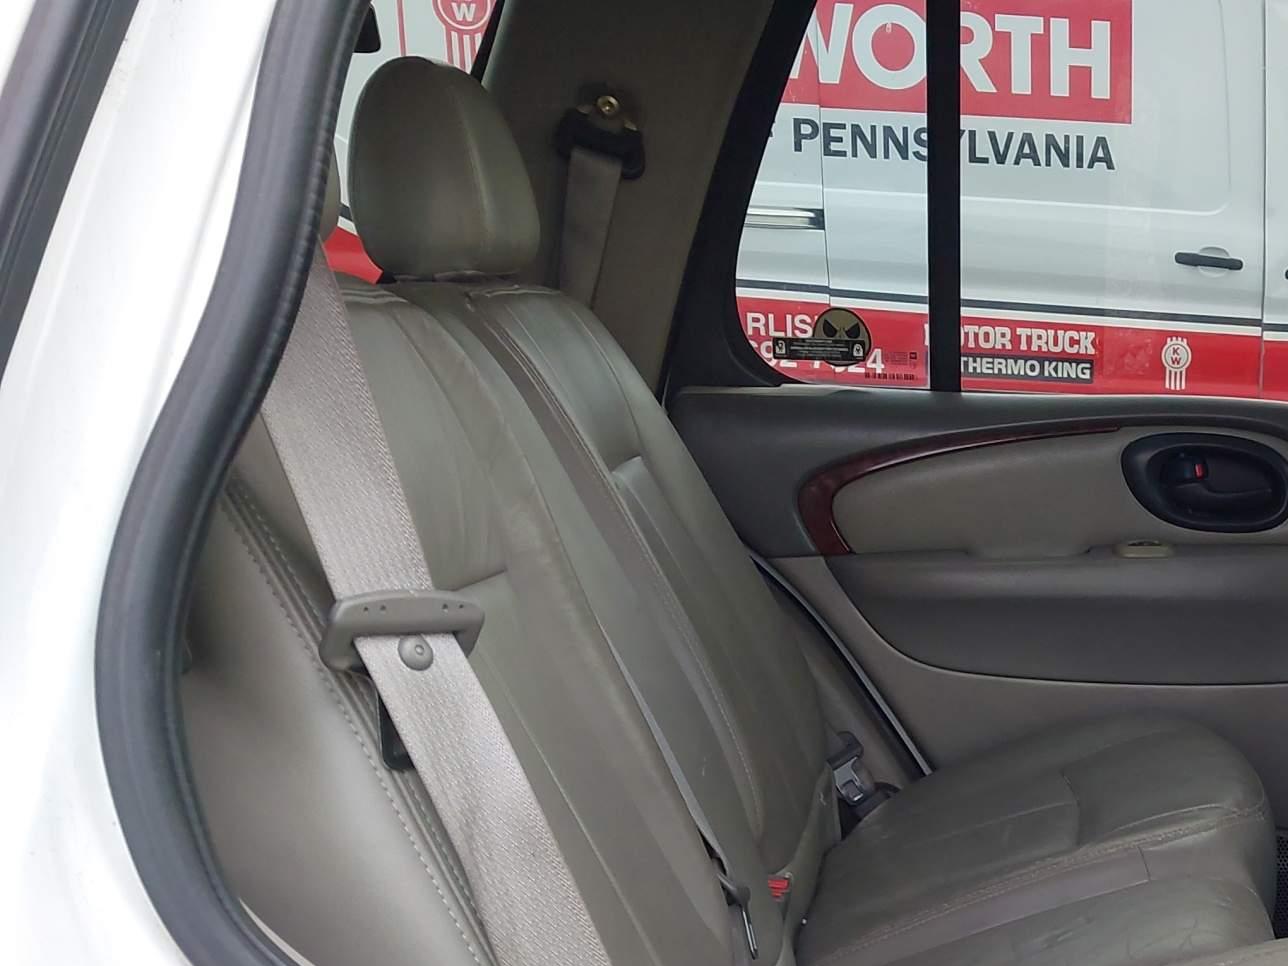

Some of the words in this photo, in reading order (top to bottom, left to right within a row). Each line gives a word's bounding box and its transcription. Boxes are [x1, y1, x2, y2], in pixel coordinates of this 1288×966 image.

[792, 117, 1116, 170] PENNSLVANIA
[747, 312, 818, 338] RLIS
[1016, 327, 1096, 355] TRUCK
[1044, 360, 1091, 379] KING
